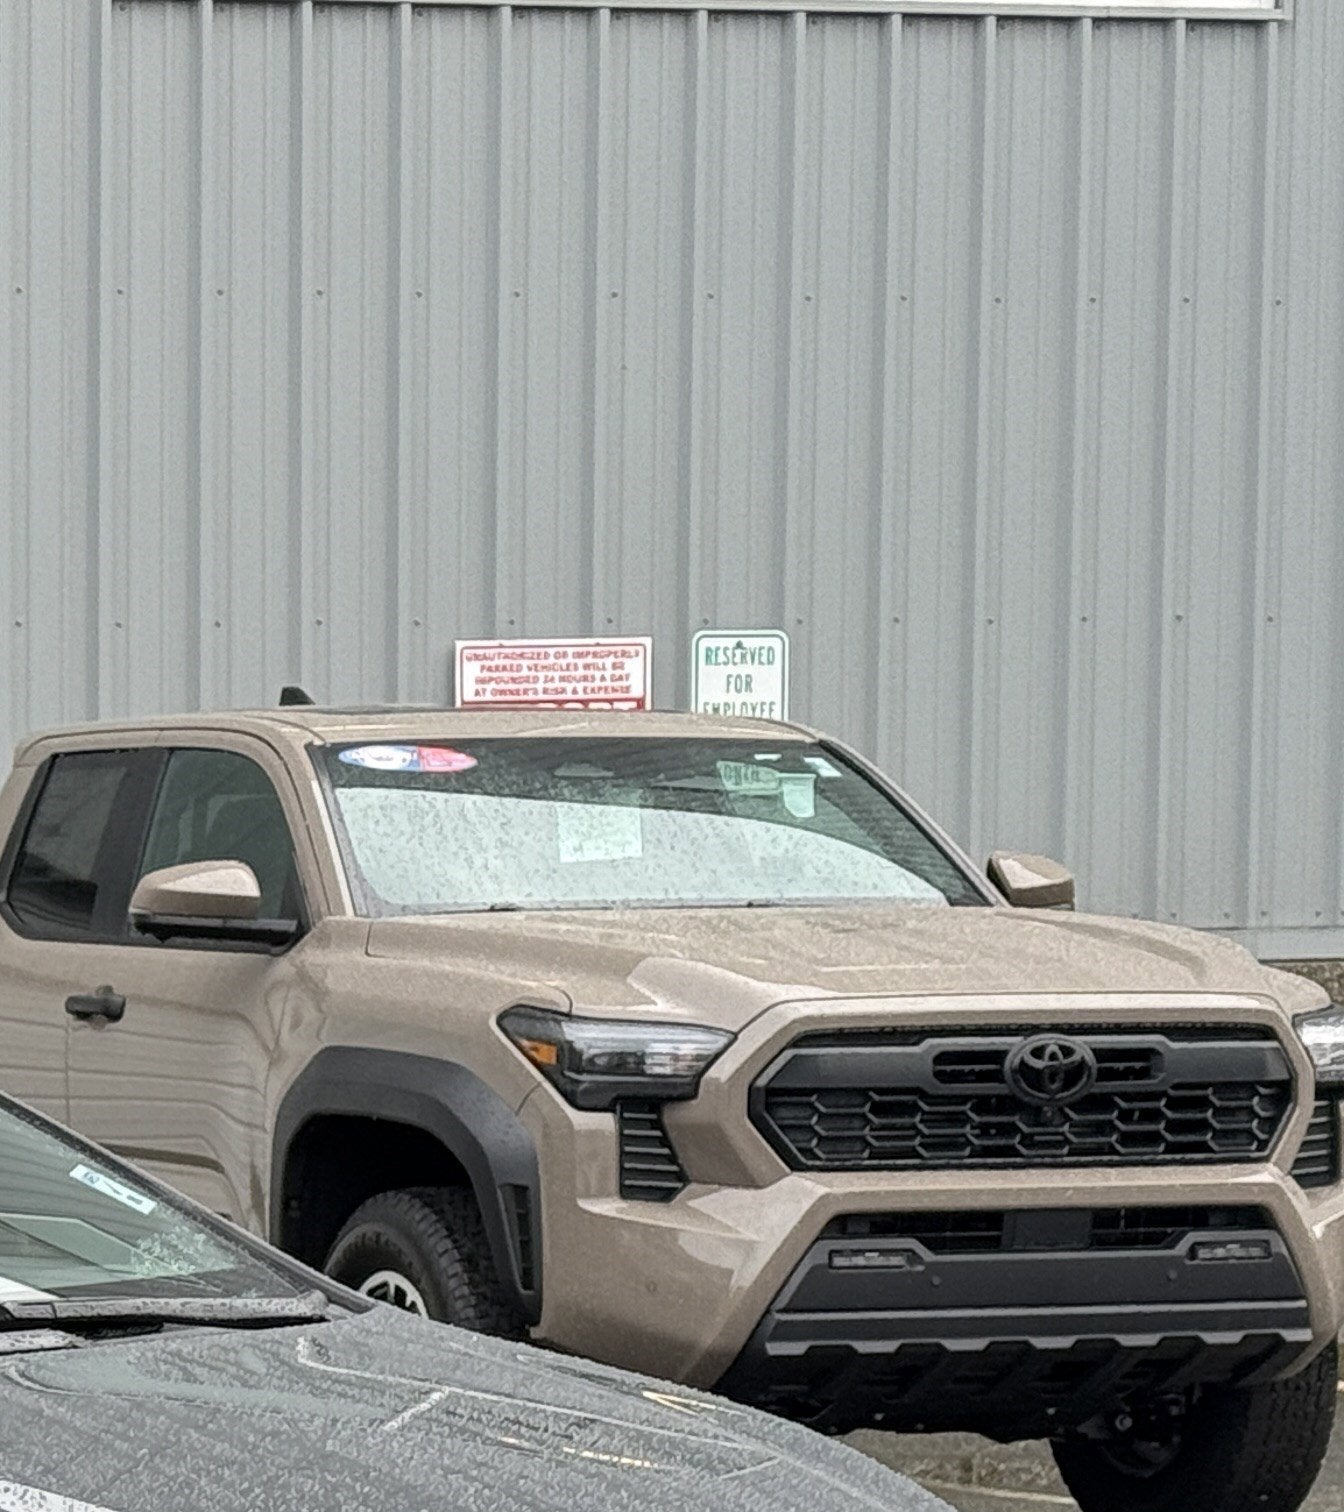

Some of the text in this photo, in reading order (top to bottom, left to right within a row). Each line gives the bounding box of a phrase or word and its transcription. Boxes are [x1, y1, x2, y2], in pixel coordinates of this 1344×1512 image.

[705, 646, 775, 666] RESERVED
[480, 663, 524, 673] PARKED
[527, 662, 579, 672] VEHICLES
[582, 661, 607, 671] WILL
[726, 673, 753, 694] FOR
[474, 687, 487, 697] AT
